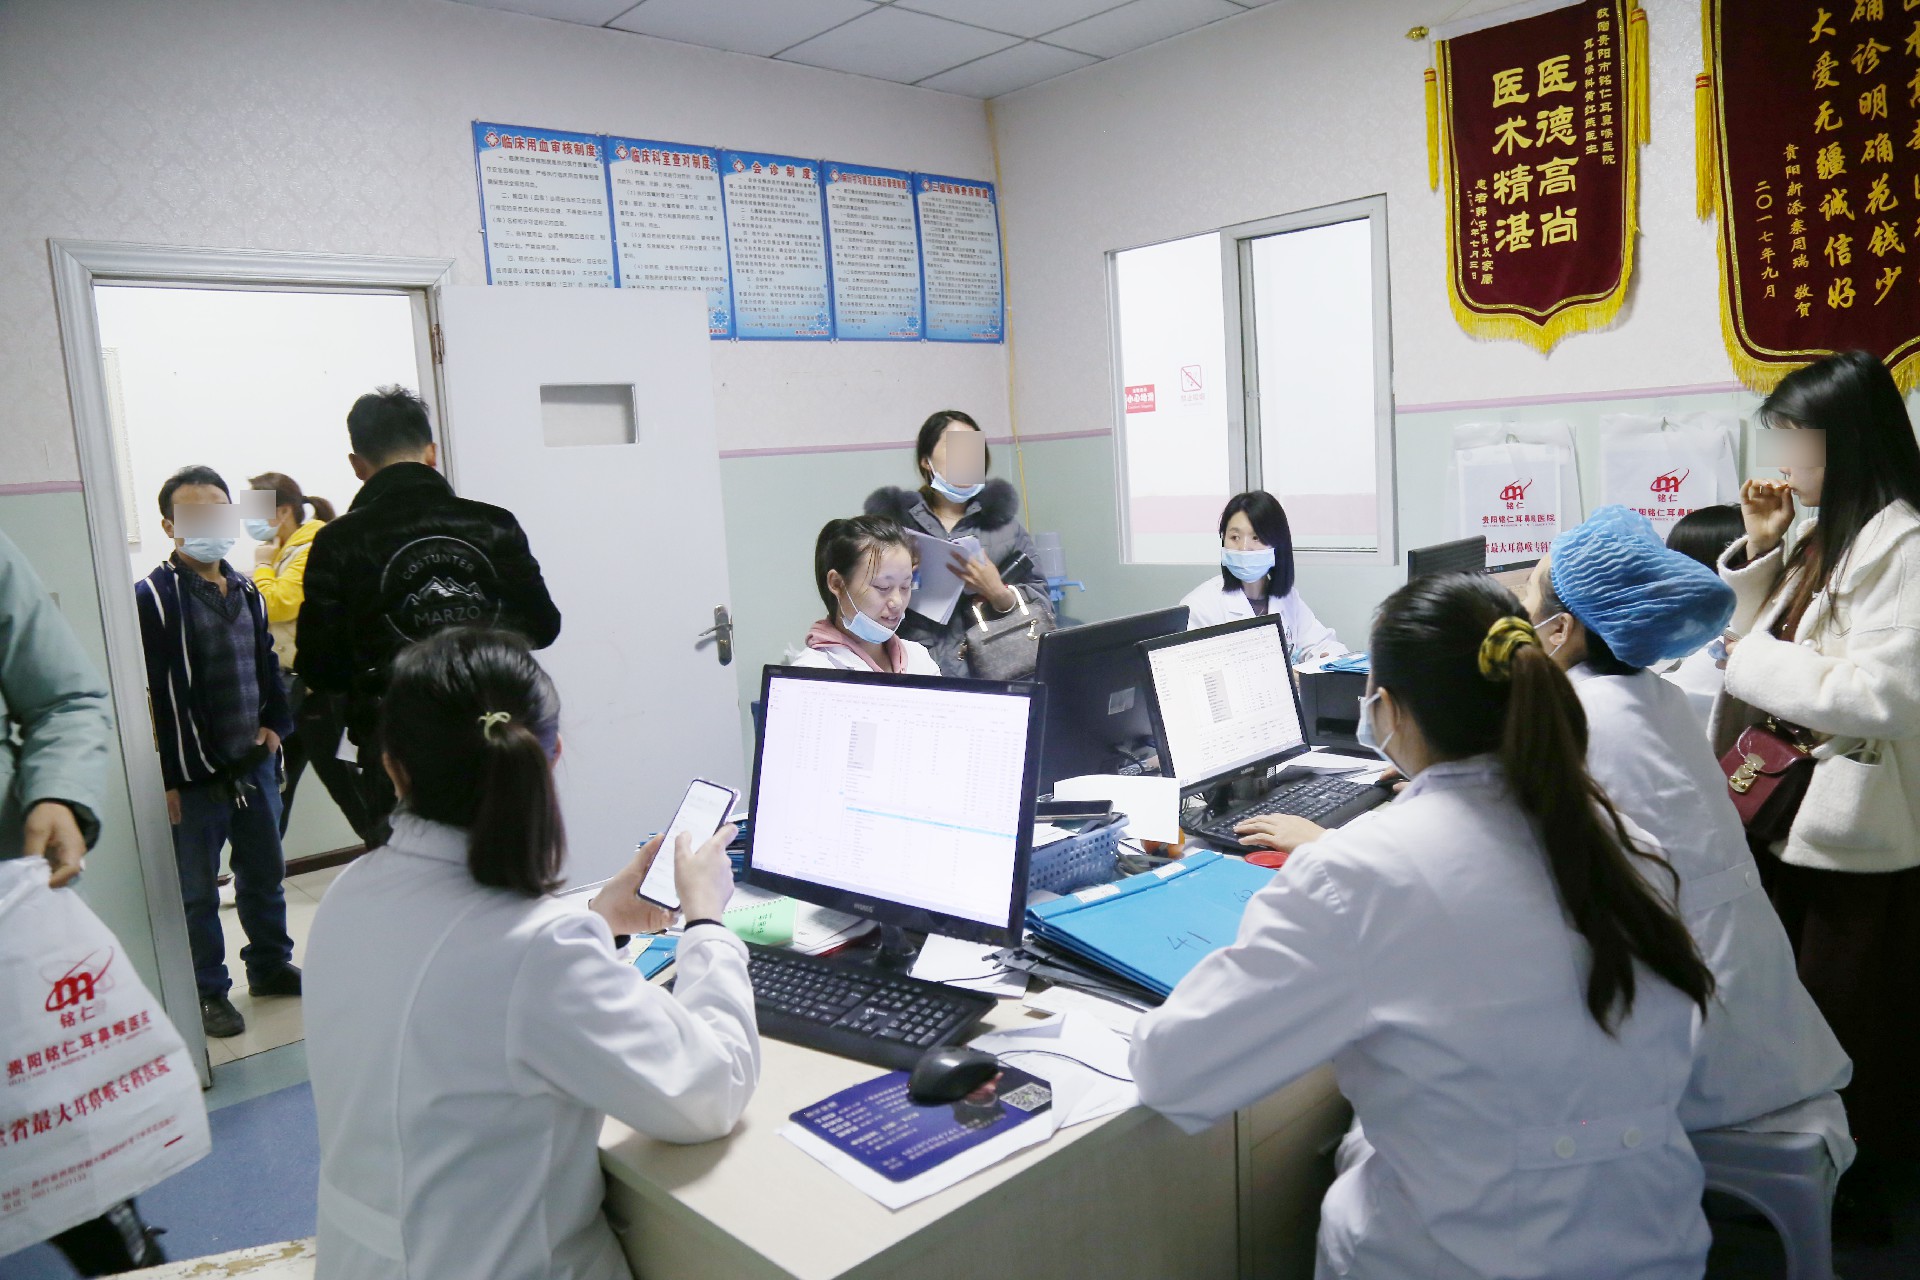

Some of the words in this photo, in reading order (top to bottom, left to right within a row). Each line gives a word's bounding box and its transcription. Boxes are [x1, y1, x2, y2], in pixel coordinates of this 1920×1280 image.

[501, 134, 597, 158] 临床用血审核制度
[1536, 54, 1578, 247] 医德高尚
[630, 148, 711, 170] 临床科室查对制度
[752, 161, 813, 180] 会诊制度
[1492, 67, 1534, 253] 医术精湛
[1809, 8, 1856, 309] 大爱无疆诚信好
[1755, 180, 1779, 299] 二〇一七年九月
[1506, 502, 1525, 510] 铭仁
[1657, 493, 1678, 503] 铭仁
[414, 605, 481, 628] MARZO
[59, 1005, 96, 1029] 铭仁
